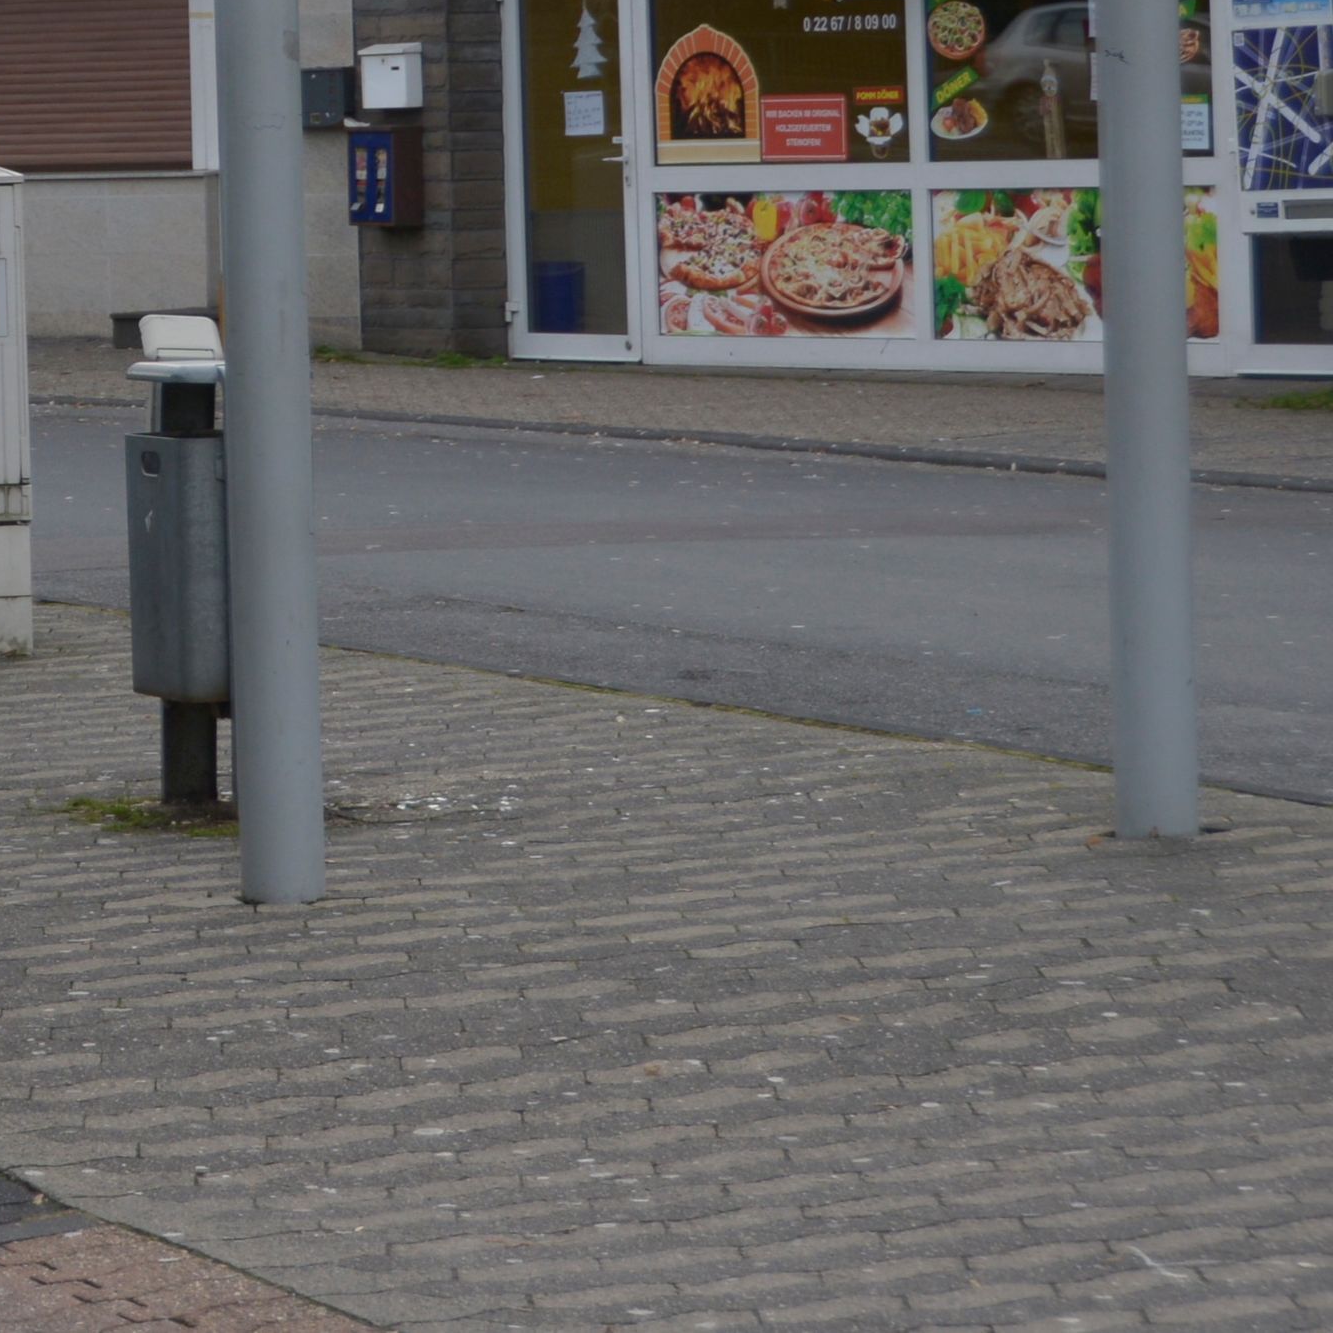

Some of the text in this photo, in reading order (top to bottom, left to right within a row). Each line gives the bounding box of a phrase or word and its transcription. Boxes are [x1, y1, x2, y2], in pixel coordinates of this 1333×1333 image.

[813, 17, 828, 32] 22
[830, 16, 845, 31] 67
[864, 14, 879, 30] 09
[881, 14, 897, 29] 00
[936, 71, 973, 104] DÖNER
